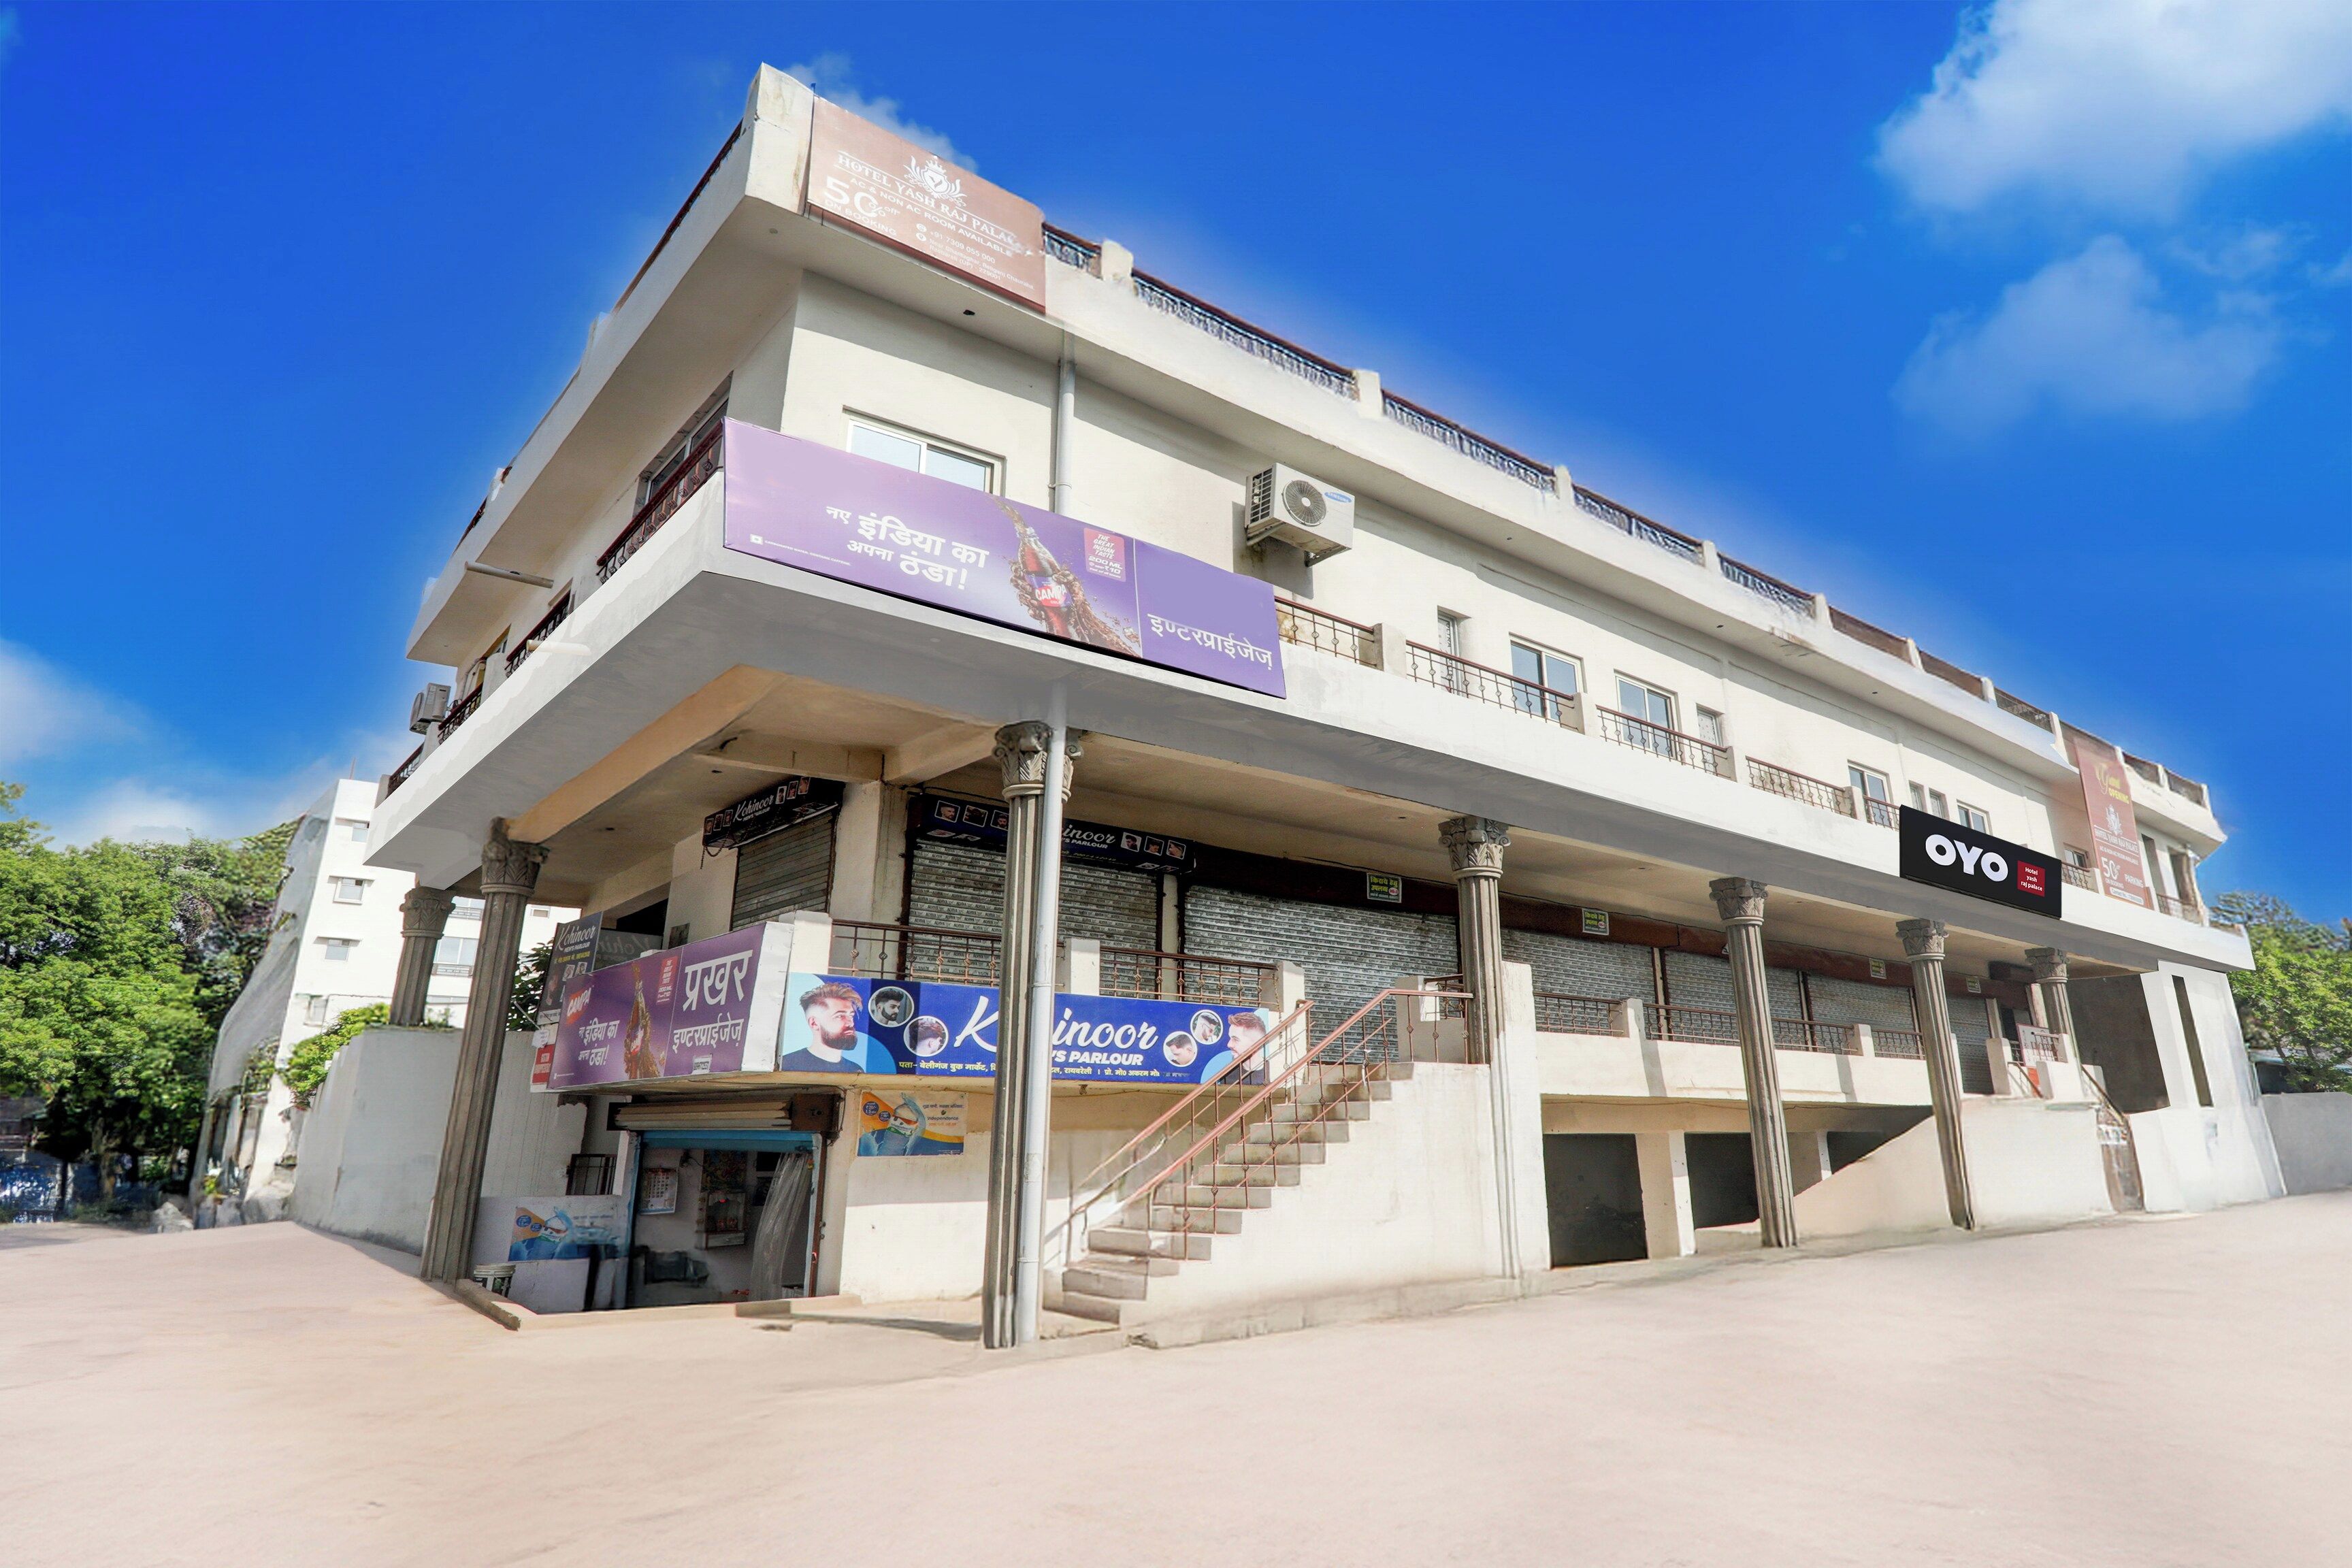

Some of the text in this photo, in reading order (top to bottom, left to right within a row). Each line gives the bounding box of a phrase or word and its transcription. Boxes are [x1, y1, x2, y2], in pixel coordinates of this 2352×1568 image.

[838, 154, 892, 187] HOTEL
[895, 180, 936, 209] YASH
[940, 203, 968, 223] RAJ
[825, 199, 898, 237] ON BOOKING
[850, 178, 866, 189] AC
[880, 191, 904, 206] NON
[906, 203, 921, 214] AC
[924, 212, 956, 231] ROOM
[958, 228, 1013, 257] AVAILABLE
[826, 506, 990, 569] नए इंडिया का
[1093, 539, 1115, 548] GREAT
[1093, 544, 1115, 555] INDIAN
[1094, 550, 1115, 559] TASTE
[847, 540, 968, 591] अपना ठंडा!
[1088, 555, 1109, 566] 200
[1109, 561, 1123, 570] ML
[1035, 584, 1068, 601] CAMPA
[1062, 824, 1116, 844] inoor
[1071, 838, 1109, 849] PARLOUR
[1925, 834, 2009, 883] OYO
[2025, 867, 2038, 875] Hotel
[2028, 883, 2043, 892] palace
[682, 949, 753, 1012] प्रखर
[584, 1018, 607, 1046] इंडिया
[607, 1020, 620, 1039] का
[955, 995, 1159, 1053] Kinoor
[589, 1043, 609, 1066] ठंडा!
[1068, 1051, 1144, 1066] PARLOUR
[919, 1060, 948, 1070] बेलीगंज
[950, 1063, 963, 1072] बुक
[1064, 1066, 1092, 1075] रायबरेली
